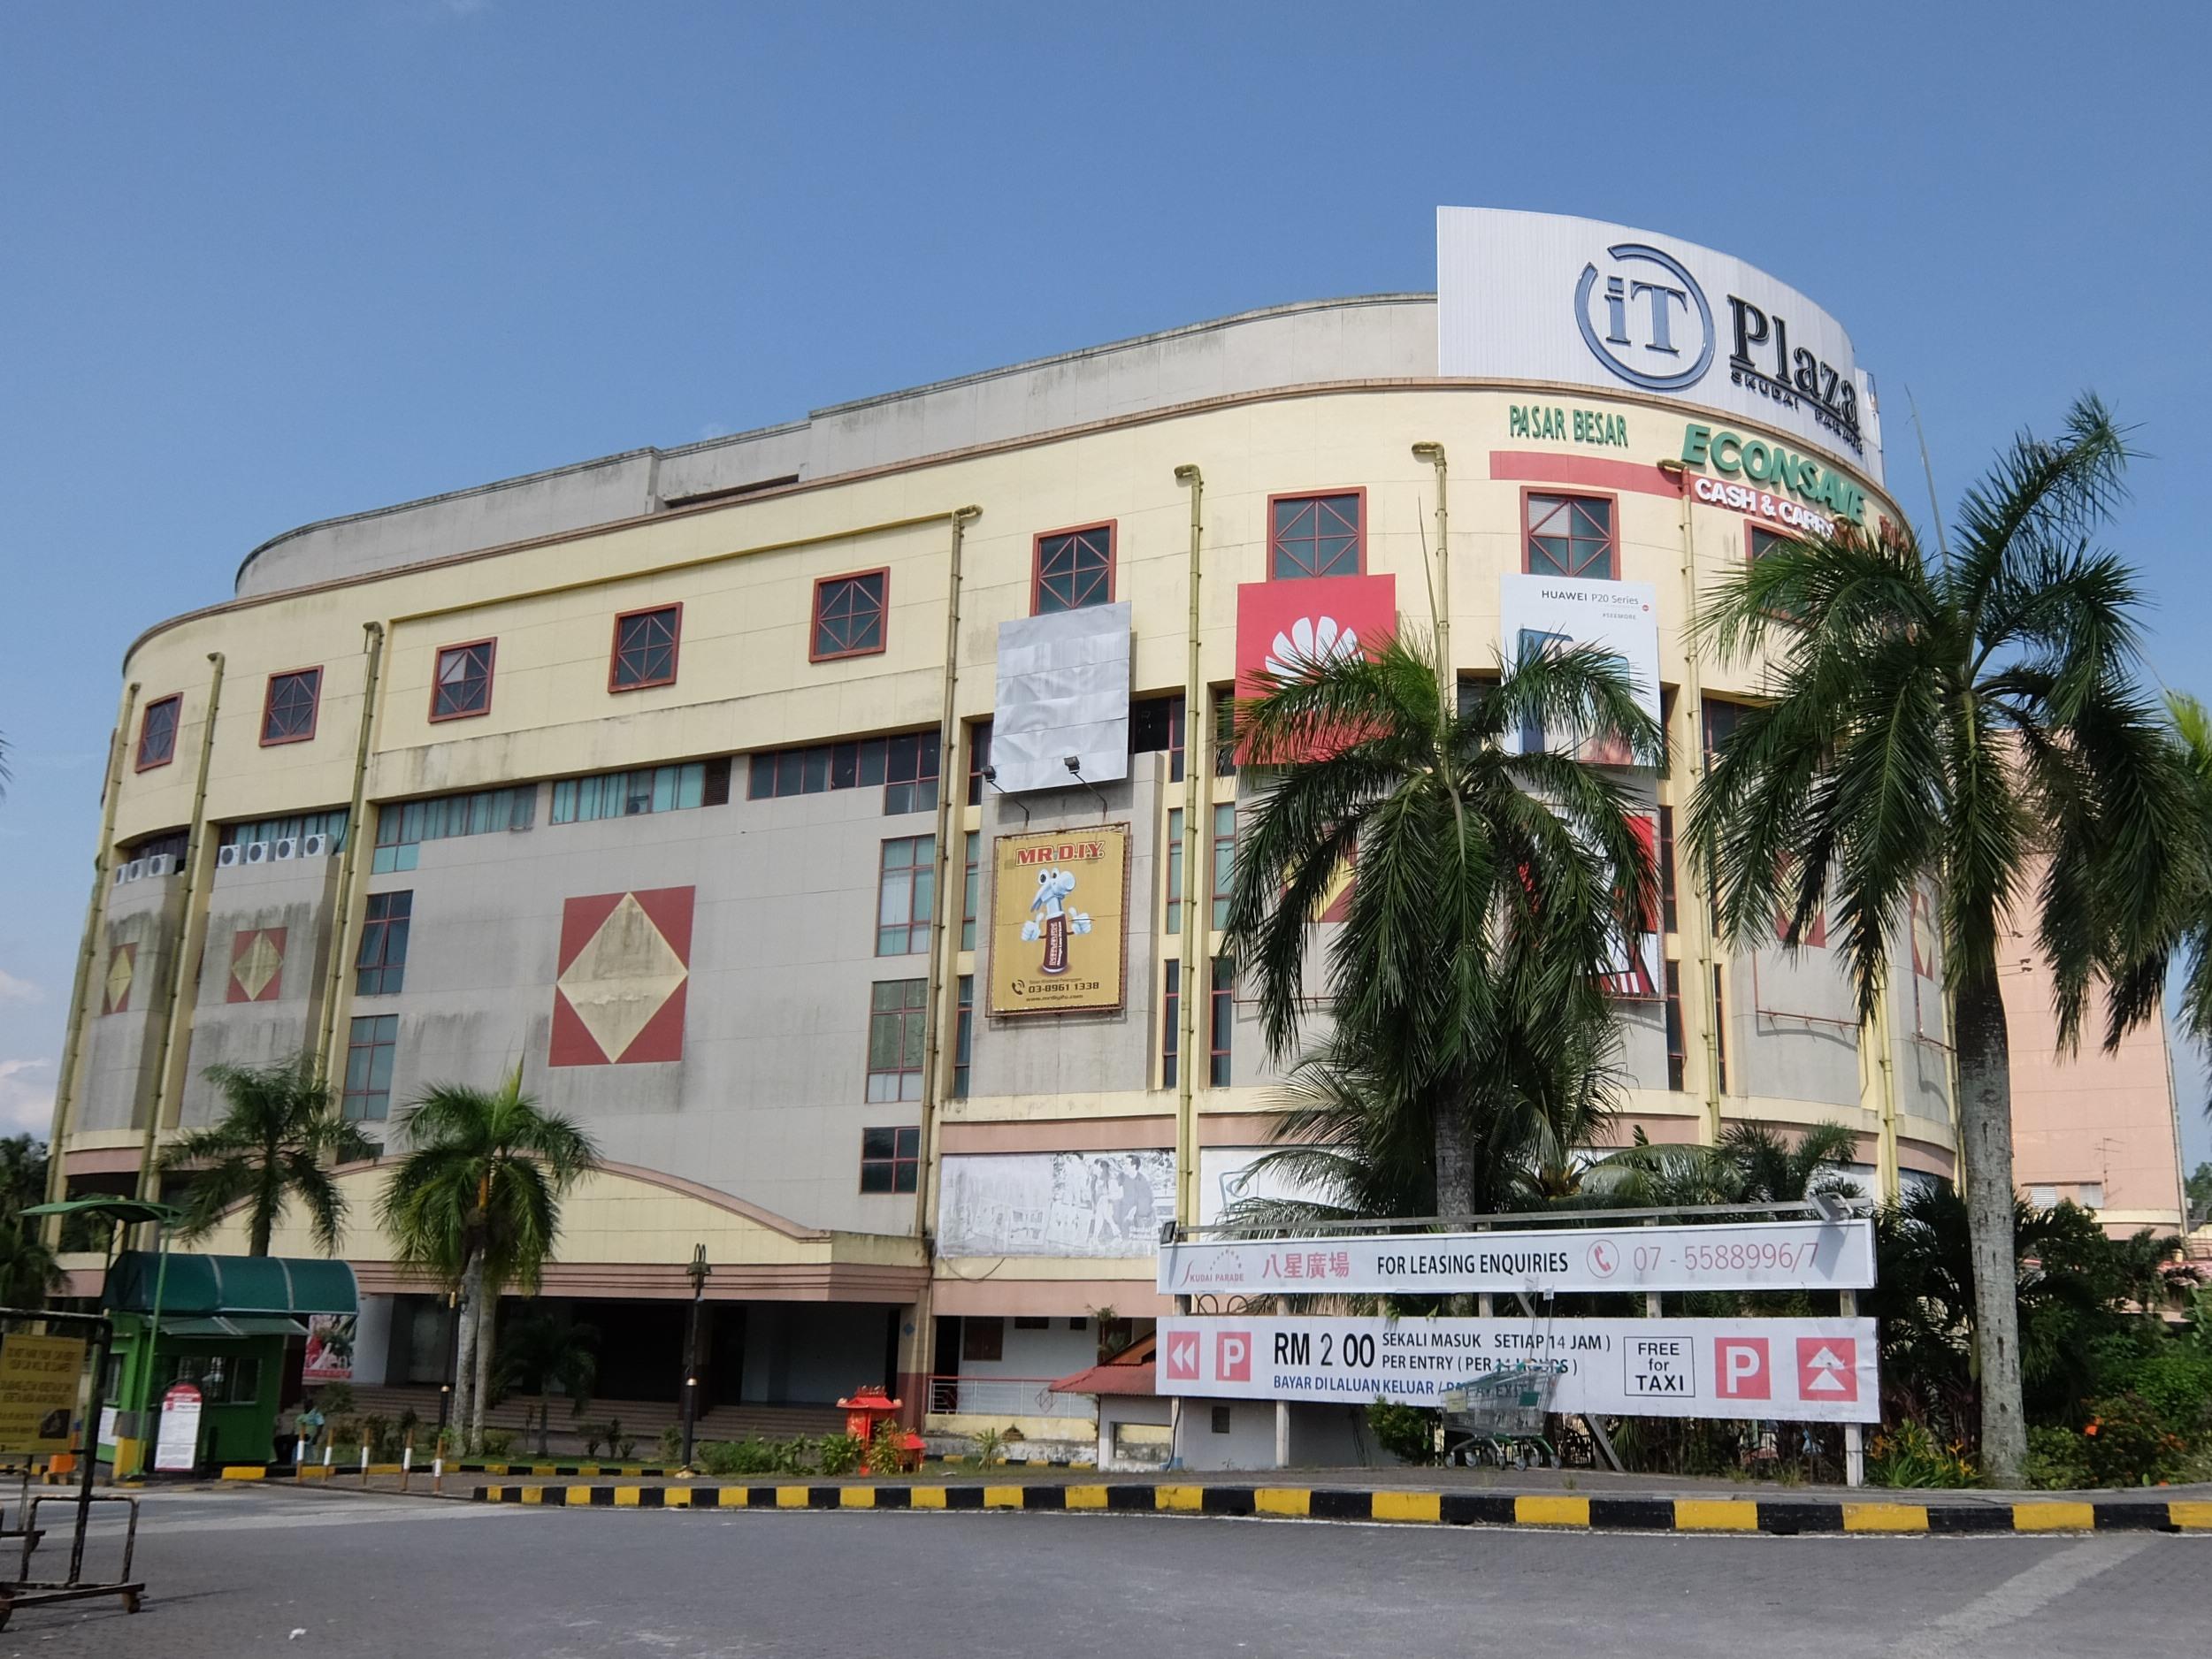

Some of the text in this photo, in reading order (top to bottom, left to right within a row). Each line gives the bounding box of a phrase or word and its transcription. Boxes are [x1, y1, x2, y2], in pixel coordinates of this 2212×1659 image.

[1727, 294, 1861, 432] Plaza
[1731, 370, 1800, 412] SKUDAI
[1510, 405, 1628, 447] PASAR BESAR
[1681, 424, 1864, 526] ECONSAVE
[1695, 478, 1757, 511] CASH
[1761, 494, 1776, 516] &
[1542, 590, 1639, 605] HUAWEI P20 Series
[1029, 982, 1099, 994] 03-8961 1338
[1262, 1251, 1351, 1280] 八星廣場
[1377, 1251, 1568, 1275] FOR LEASING ENQUIRIES
[1634, 1246, 1661, 1271] 07
[1684, 1242, 1819, 1274] 5588996/7
[1215, 1273, 1244, 1282] PARADE
[1274, 1332, 1310, 1366] RM
[1382, 1332, 1427, 1347] SEKALI
[1431, 1333, 1481, 1348] MASUK
[1494, 1334, 1544, 1349] SETIAP
[1549, 1334, 1565, 1350] 14
[1637, 1342, 1680, 1356] FREE
[1382, 1354, 1405, 1370] PER
[1410, 1355, 1453, 1371] ENTRY
[1648, 1357, 1670, 1372] for
[1726, 1345, 1760, 1394] P
[1274, 1375, 1312, 1390] BAYAR
[1330, 1378, 1380, 1393] LALUAN
[1383, 1380, 1434, 1395] KELUAR
[1635, 1374, 1684, 1392] TAXI
